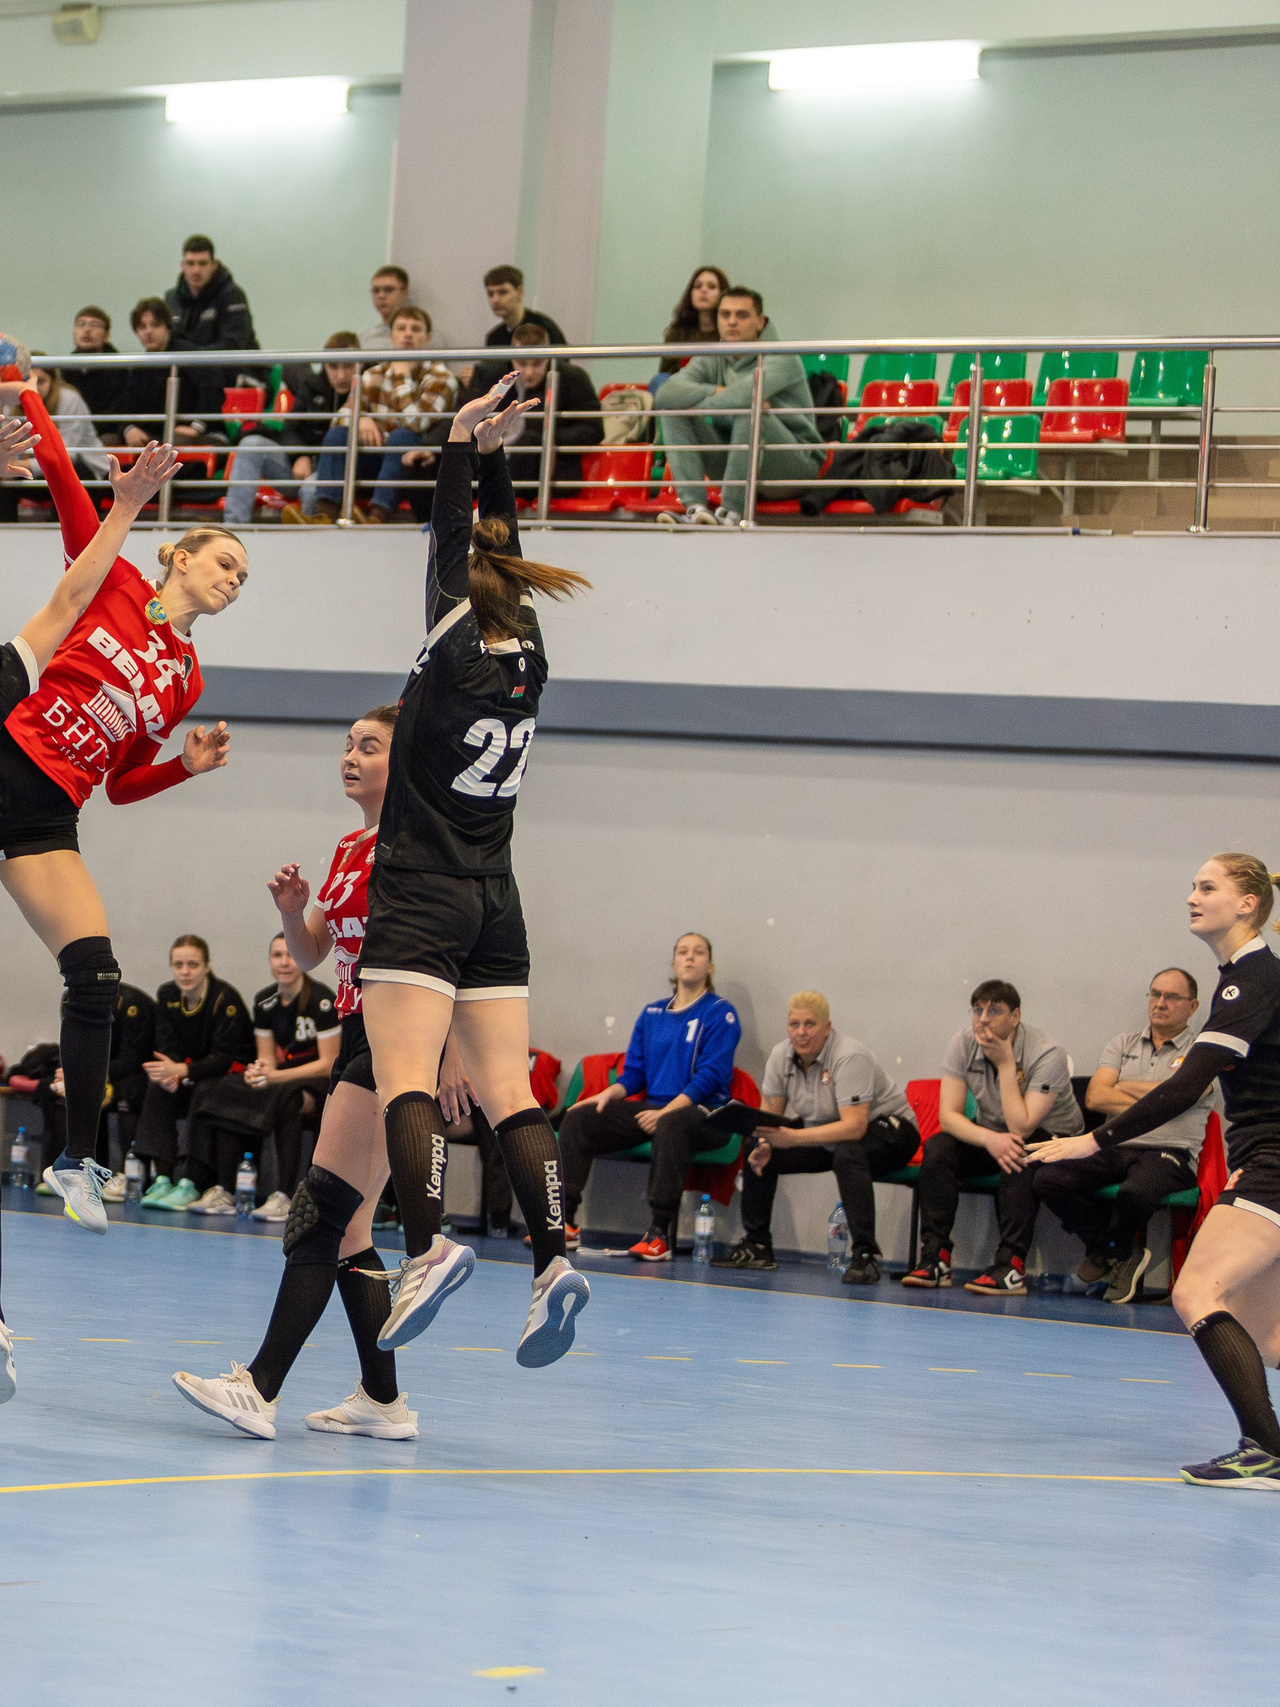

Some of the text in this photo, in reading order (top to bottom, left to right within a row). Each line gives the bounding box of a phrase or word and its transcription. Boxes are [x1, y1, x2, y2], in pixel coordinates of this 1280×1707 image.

[133, 629, 181, 694] 34
[450, 717, 536, 797] 22
[685, 1017, 700, 1043] 1
[427, 1133, 448, 1200] Kempa
[543, 1160, 564, 1231] Kempa
